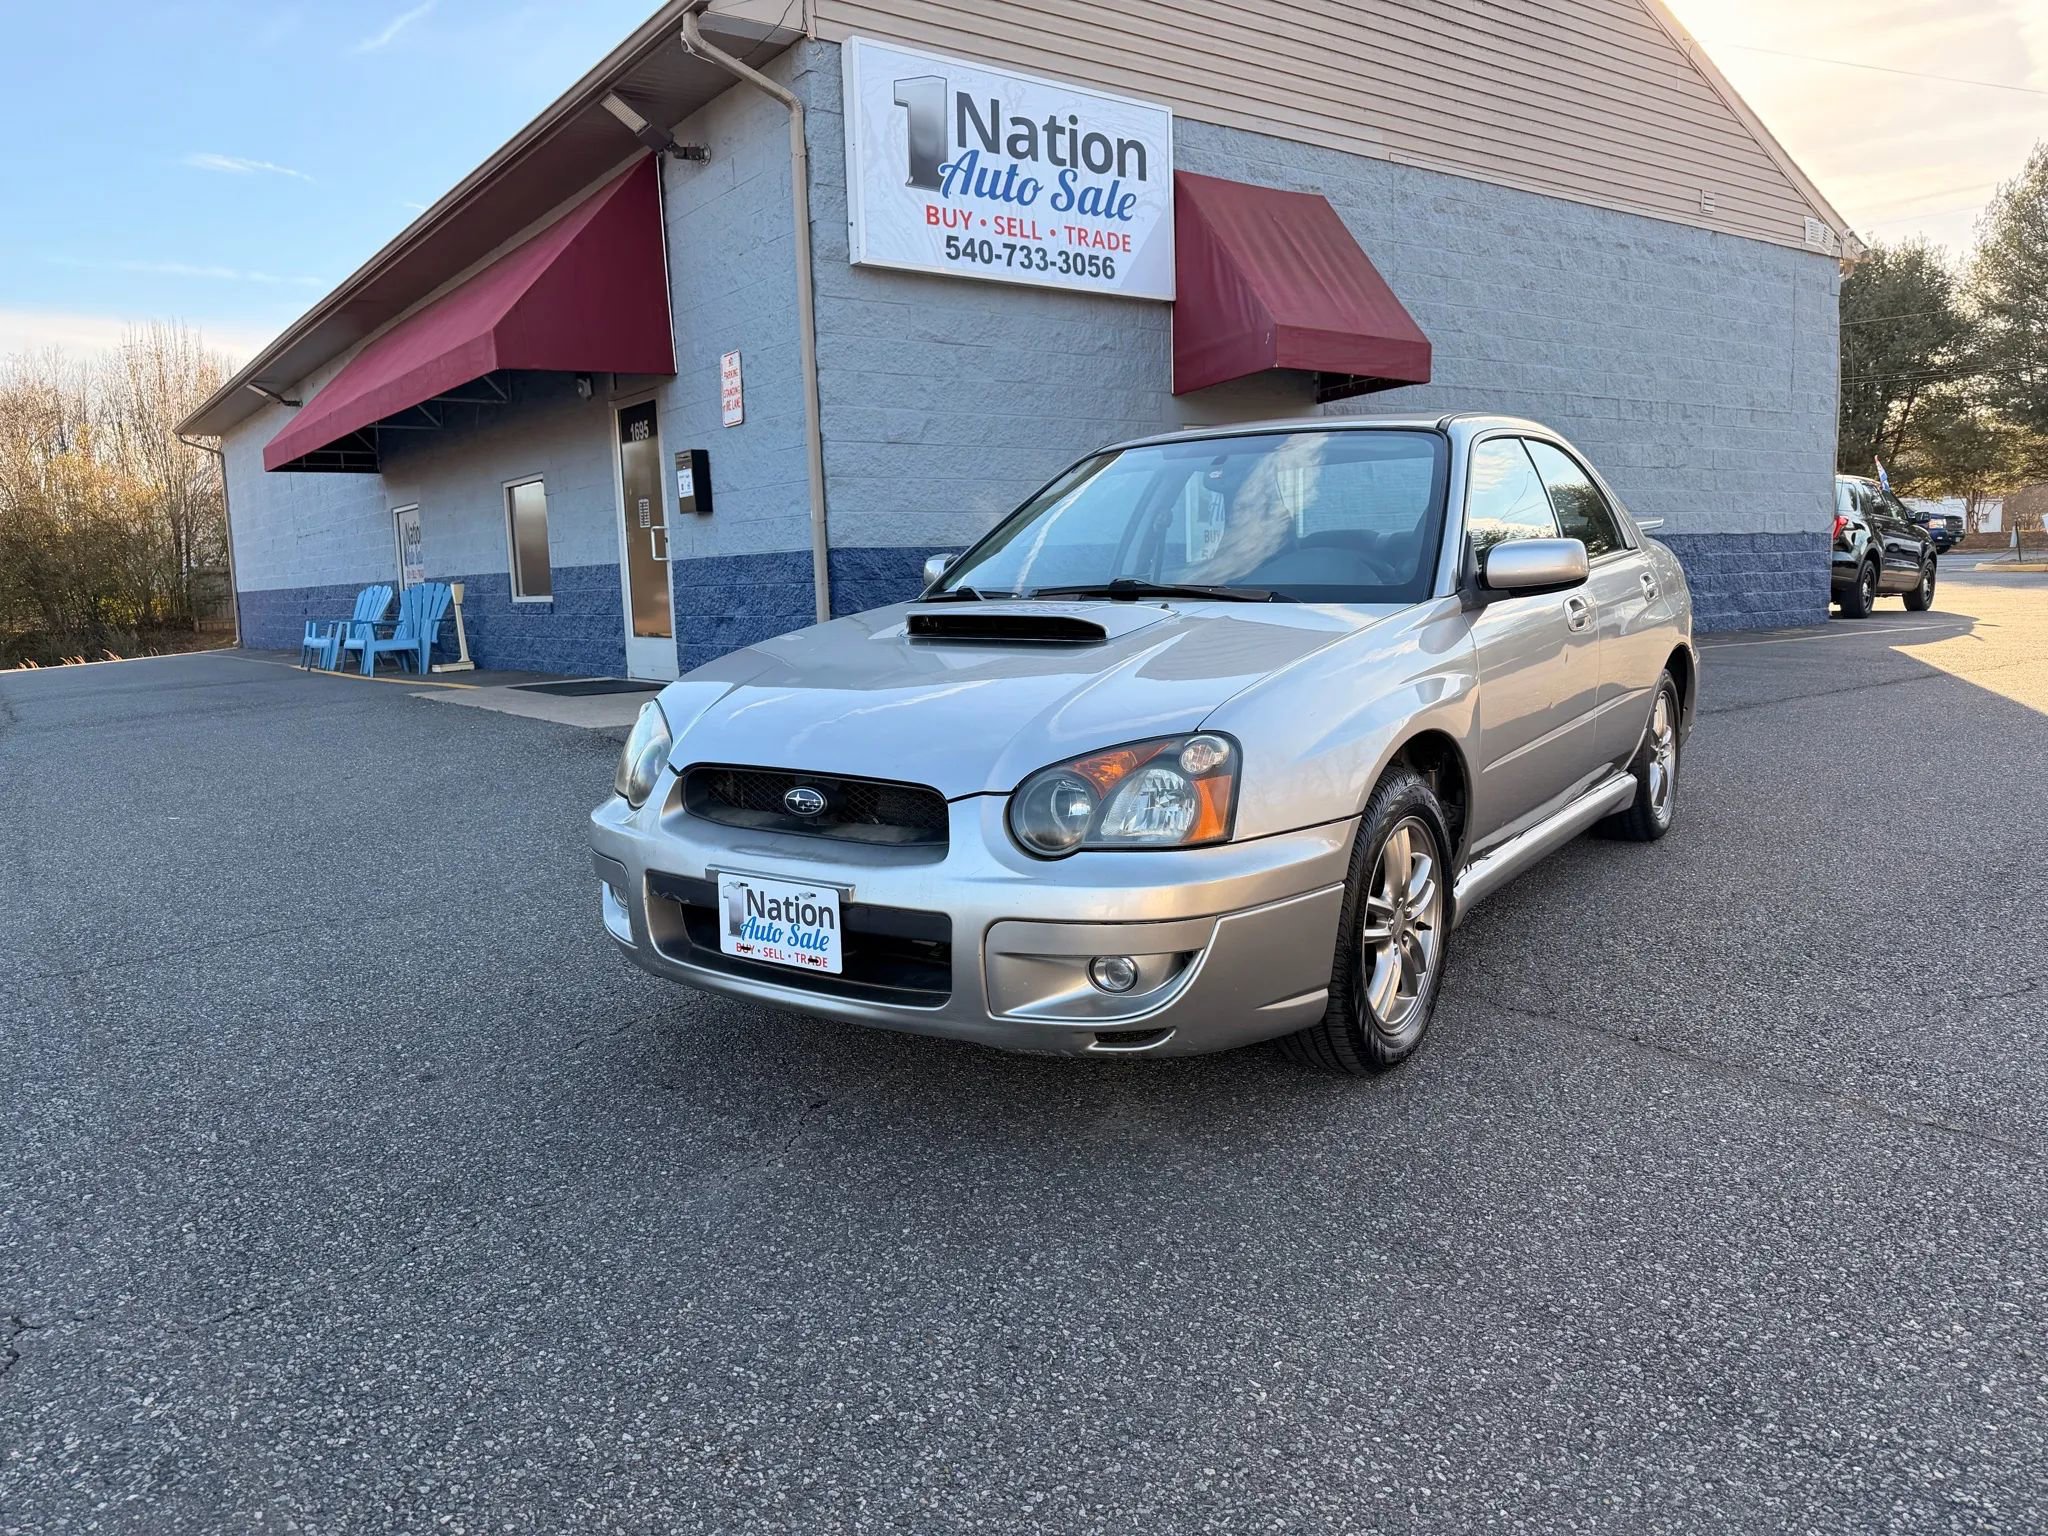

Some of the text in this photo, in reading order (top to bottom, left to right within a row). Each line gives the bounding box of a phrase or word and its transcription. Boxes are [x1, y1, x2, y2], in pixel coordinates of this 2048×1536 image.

[956, 91, 1147, 181] Nation
[939, 150, 1137, 222] Auto Sale
[926, 205, 1132, 252] BUY SELL TRADE
[945, 235, 1116, 280] 540-733-3056
[630, 419, 649, 441] 1695
[746, 889, 835, 929] Nation
[740, 916, 830, 951] Auto Sale
[763, 947, 785, 961] SELL
